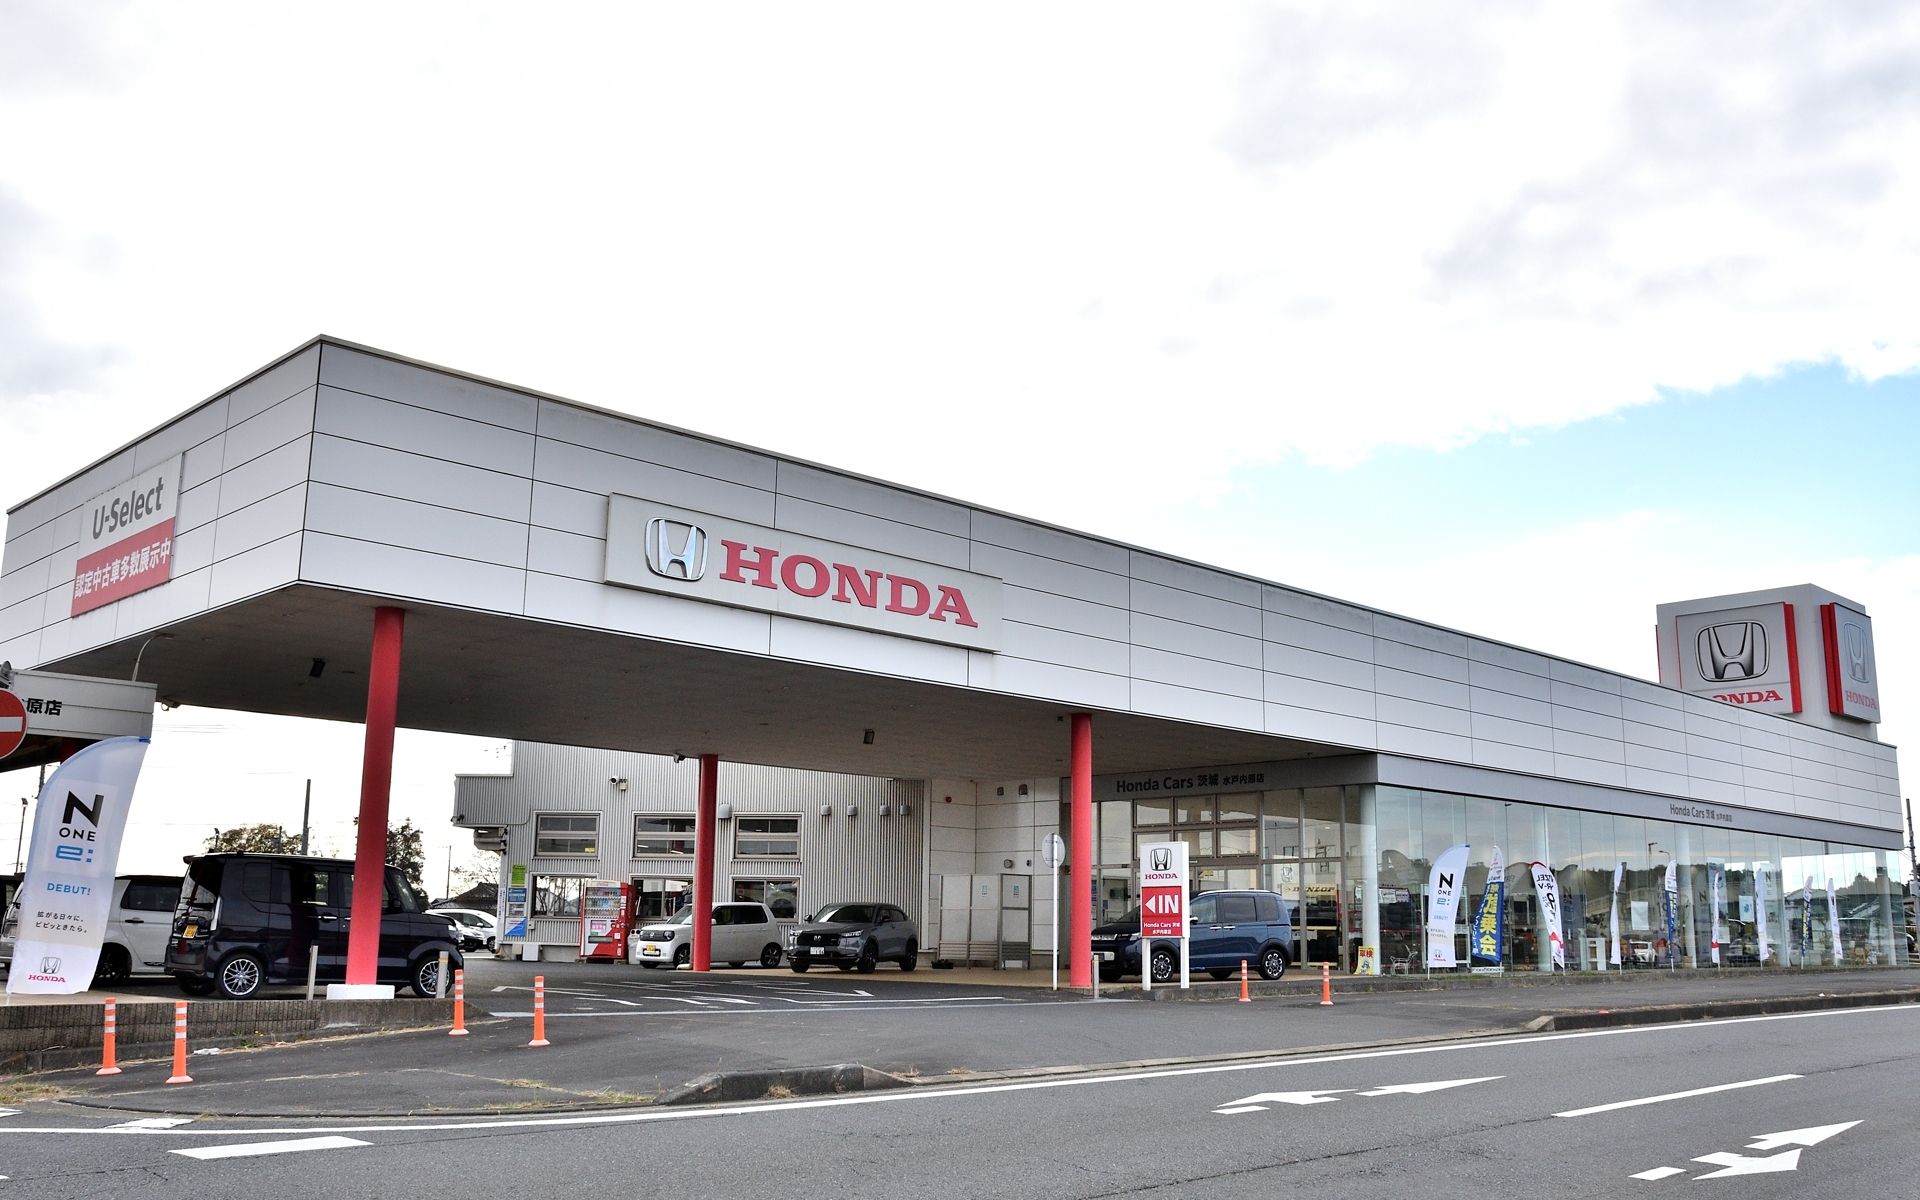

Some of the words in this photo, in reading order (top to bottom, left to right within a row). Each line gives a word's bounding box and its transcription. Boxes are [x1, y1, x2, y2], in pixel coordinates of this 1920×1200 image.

[93, 477, 164, 540] U-Select
[74, 537, 171, 599] 認定中古車多数展示中
[720, 539, 978, 628] HONDA
[1713, 690, 1783, 704] ONDA
[1845, 690, 1877, 710] HONDA
[22, 698, 62, 716] 原店
[1116, 778, 1160, 793] Honda
[1163, 776, 1194, 790] Cars
[1197, 773, 1219, 787] 茨城
[1222, 773, 1265, 786] 水戸内原店
[62, 790, 104, 828] N
[1669, 803, 1690, 817] Honda
[1691, 807, 1705, 819] Cars
[59, 827, 97, 842] ONE
[46, 882, 91, 896] DEBUT!
[1438, 872, 1454, 889] N
[1437, 889, 1452, 897] ONE
[1158, 894, 1179, 914] IN
[28, 974, 66, 983] HONDA
